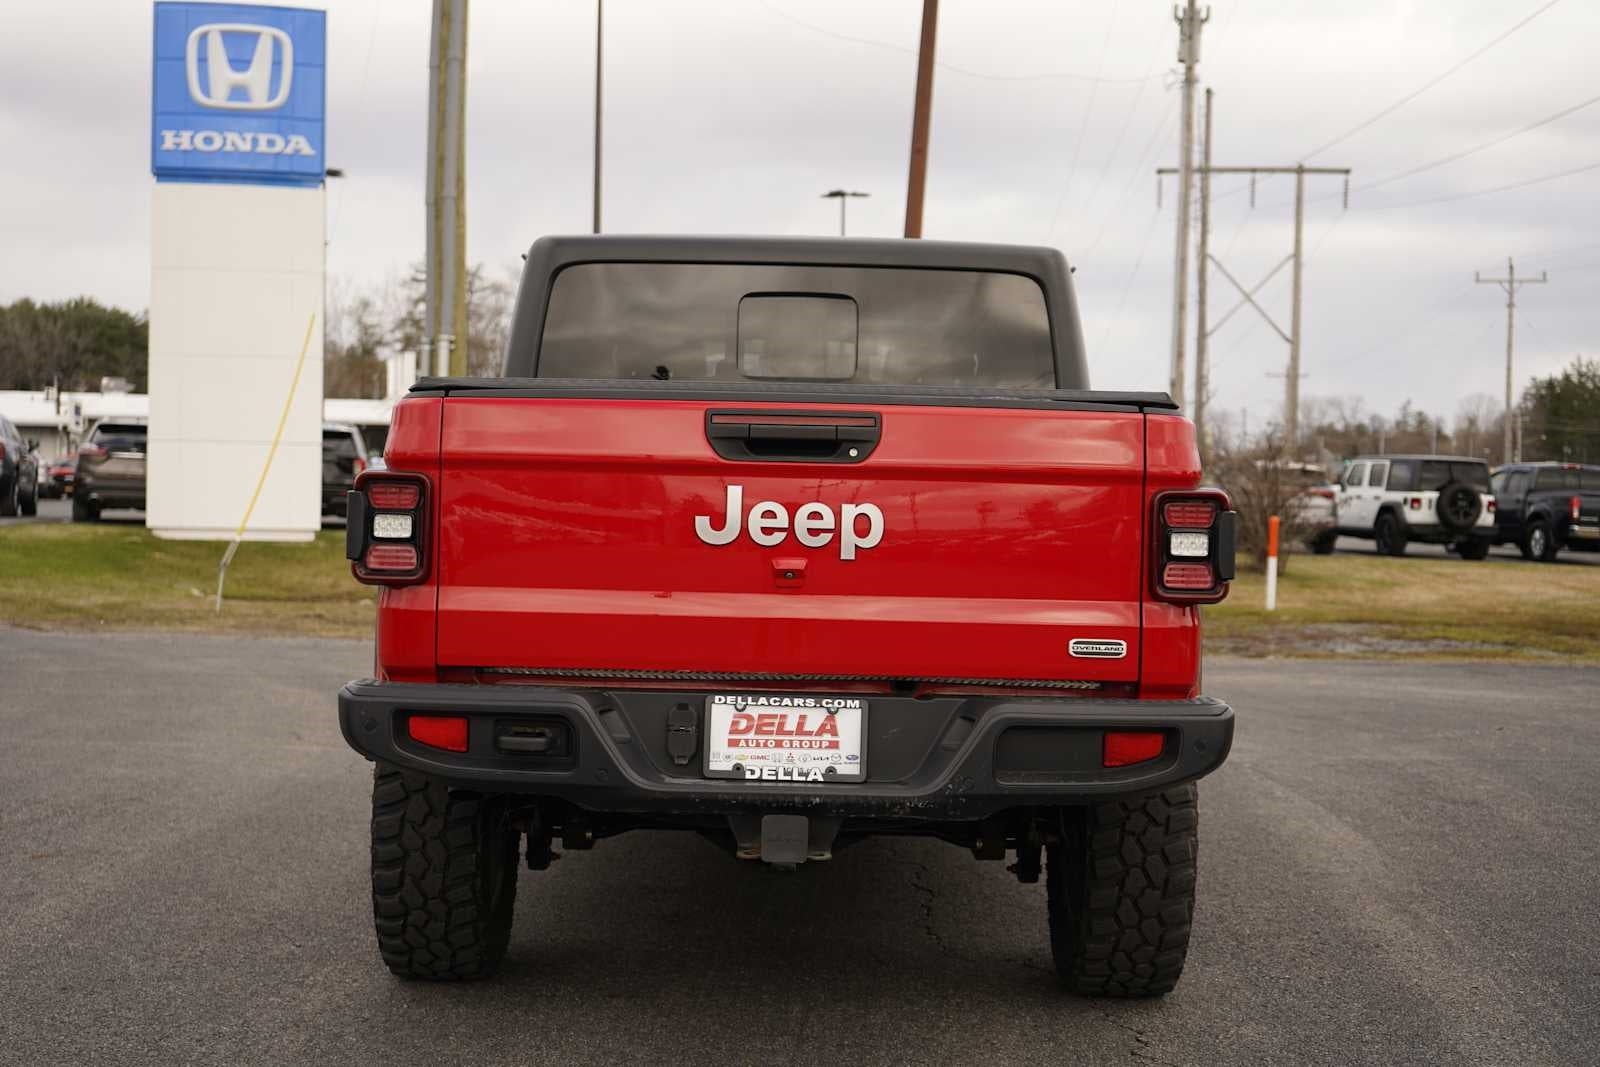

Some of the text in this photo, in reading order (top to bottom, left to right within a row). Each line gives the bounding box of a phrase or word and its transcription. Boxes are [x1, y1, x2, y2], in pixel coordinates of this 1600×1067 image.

[160, 129, 316, 156] HONDA
[694, 485, 885, 560] Jeep
[714, 695, 860, 709] DELLACARS.COM
[728, 713, 839, 736] DELLA
[739, 739, 830, 749] AUTO GROUP
[745, 766, 824, 782] DELLA
